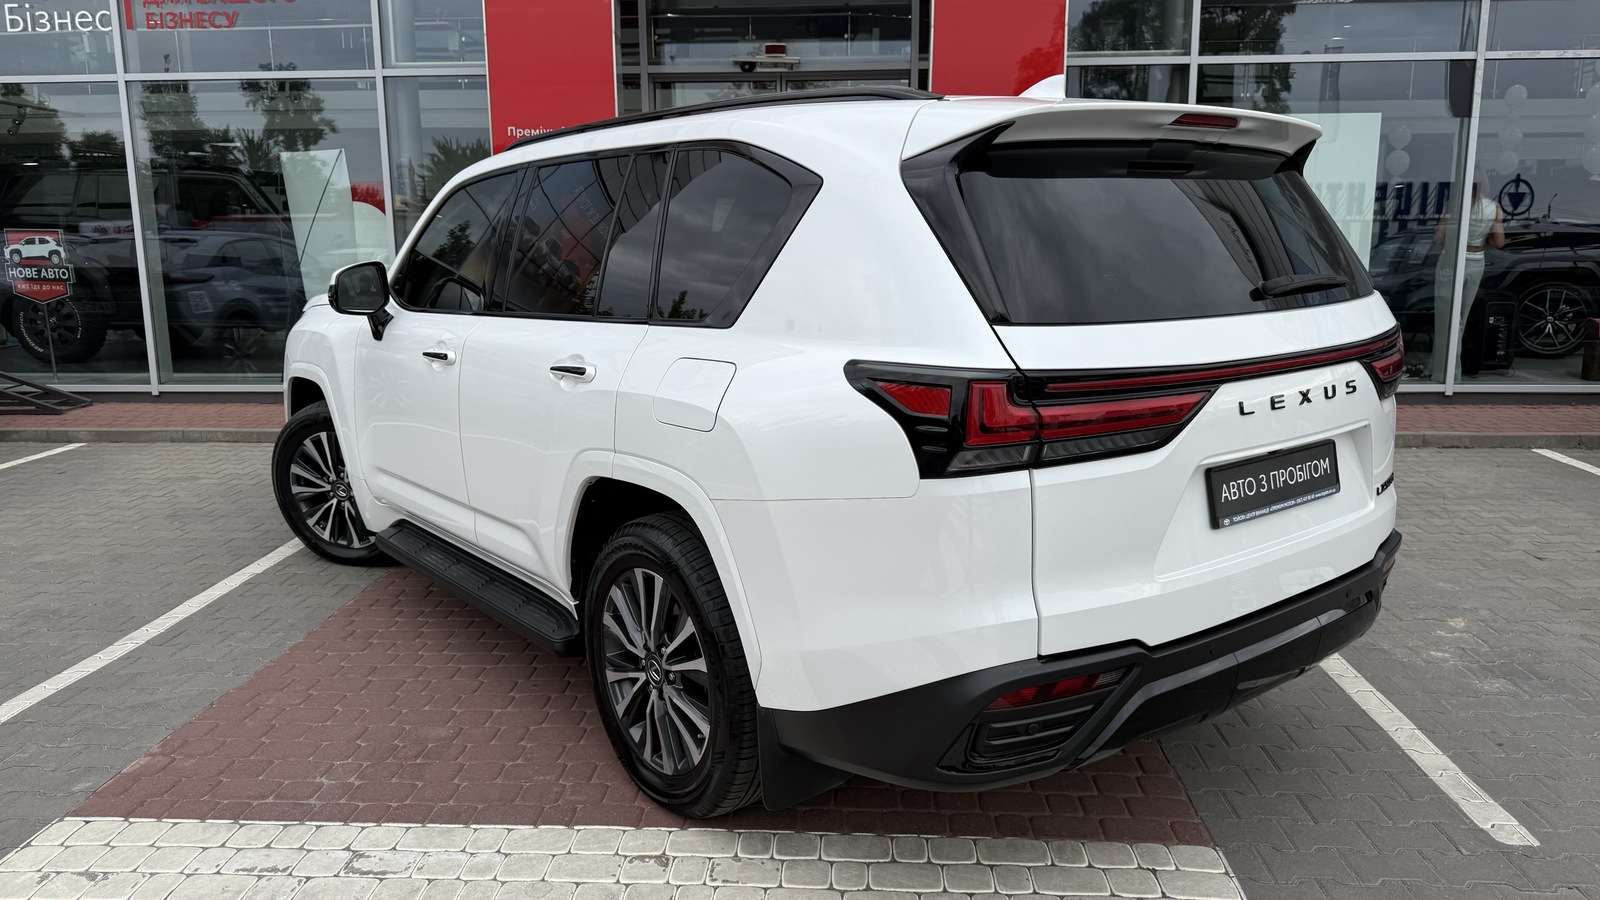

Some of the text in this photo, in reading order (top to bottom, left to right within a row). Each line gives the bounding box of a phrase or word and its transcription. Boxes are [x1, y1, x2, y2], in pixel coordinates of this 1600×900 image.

[4, 3, 112, 32] Бізнес
[145, 10, 237, 30] БІЗНЕСУ
[507, 126, 553, 139] Премі
[9, 267, 69, 279] НОВЕ АВТО
[1238, 379, 1358, 416] LEXUS
[1221, 477, 1257, 502] АВТО
[1270, 457, 1331, 490] ПРОБІГОМ
